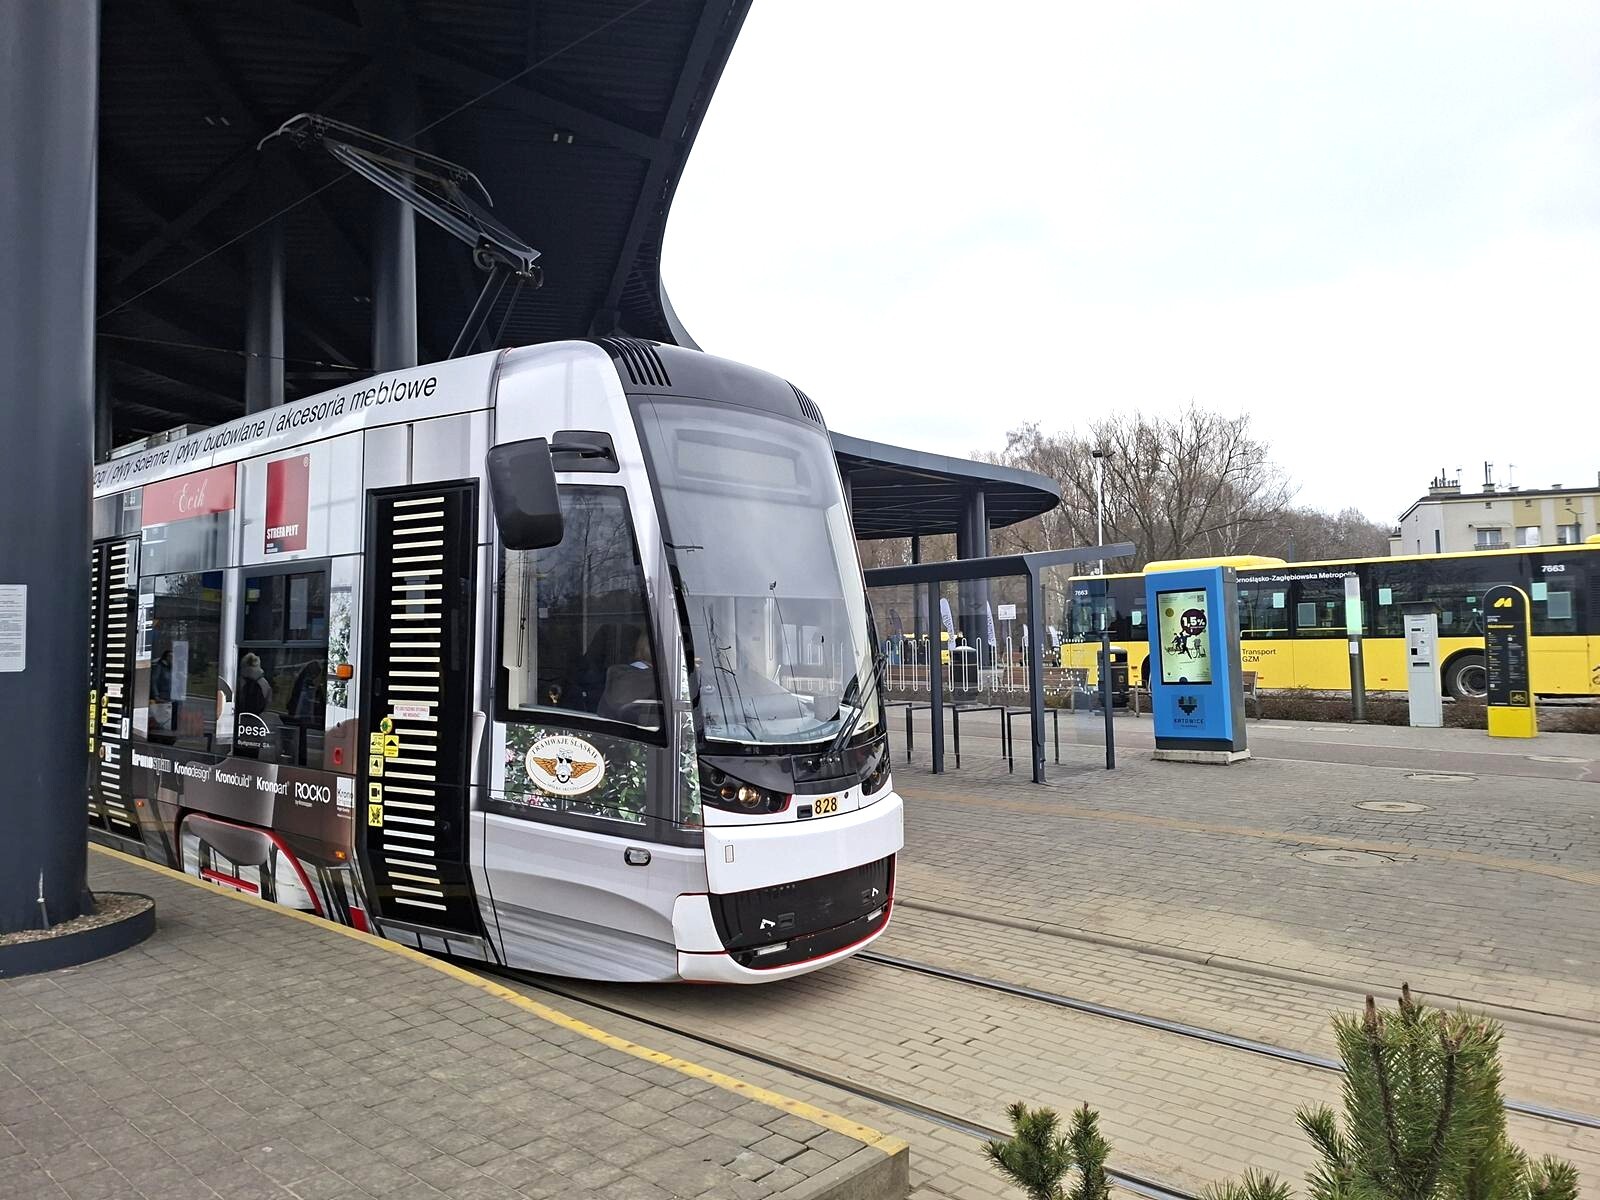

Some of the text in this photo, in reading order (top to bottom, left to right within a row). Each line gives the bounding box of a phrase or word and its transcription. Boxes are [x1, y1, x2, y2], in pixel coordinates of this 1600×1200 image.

[176, 438, 202, 464] płyty
[203, 419, 266, 452] budowlane
[276, 393, 346, 432] akcesoria
[350, 376, 437, 411] meblowe
[1182, 616, 1205, 628] 1,5%
[1242, 648, 1276, 656] Transport
[237, 724, 266, 737] pesa
[531, 738, 569, 755] TRAMWAJE
[295, 782, 331, 803] ROCKO
[815, 797, 838, 814] 828
